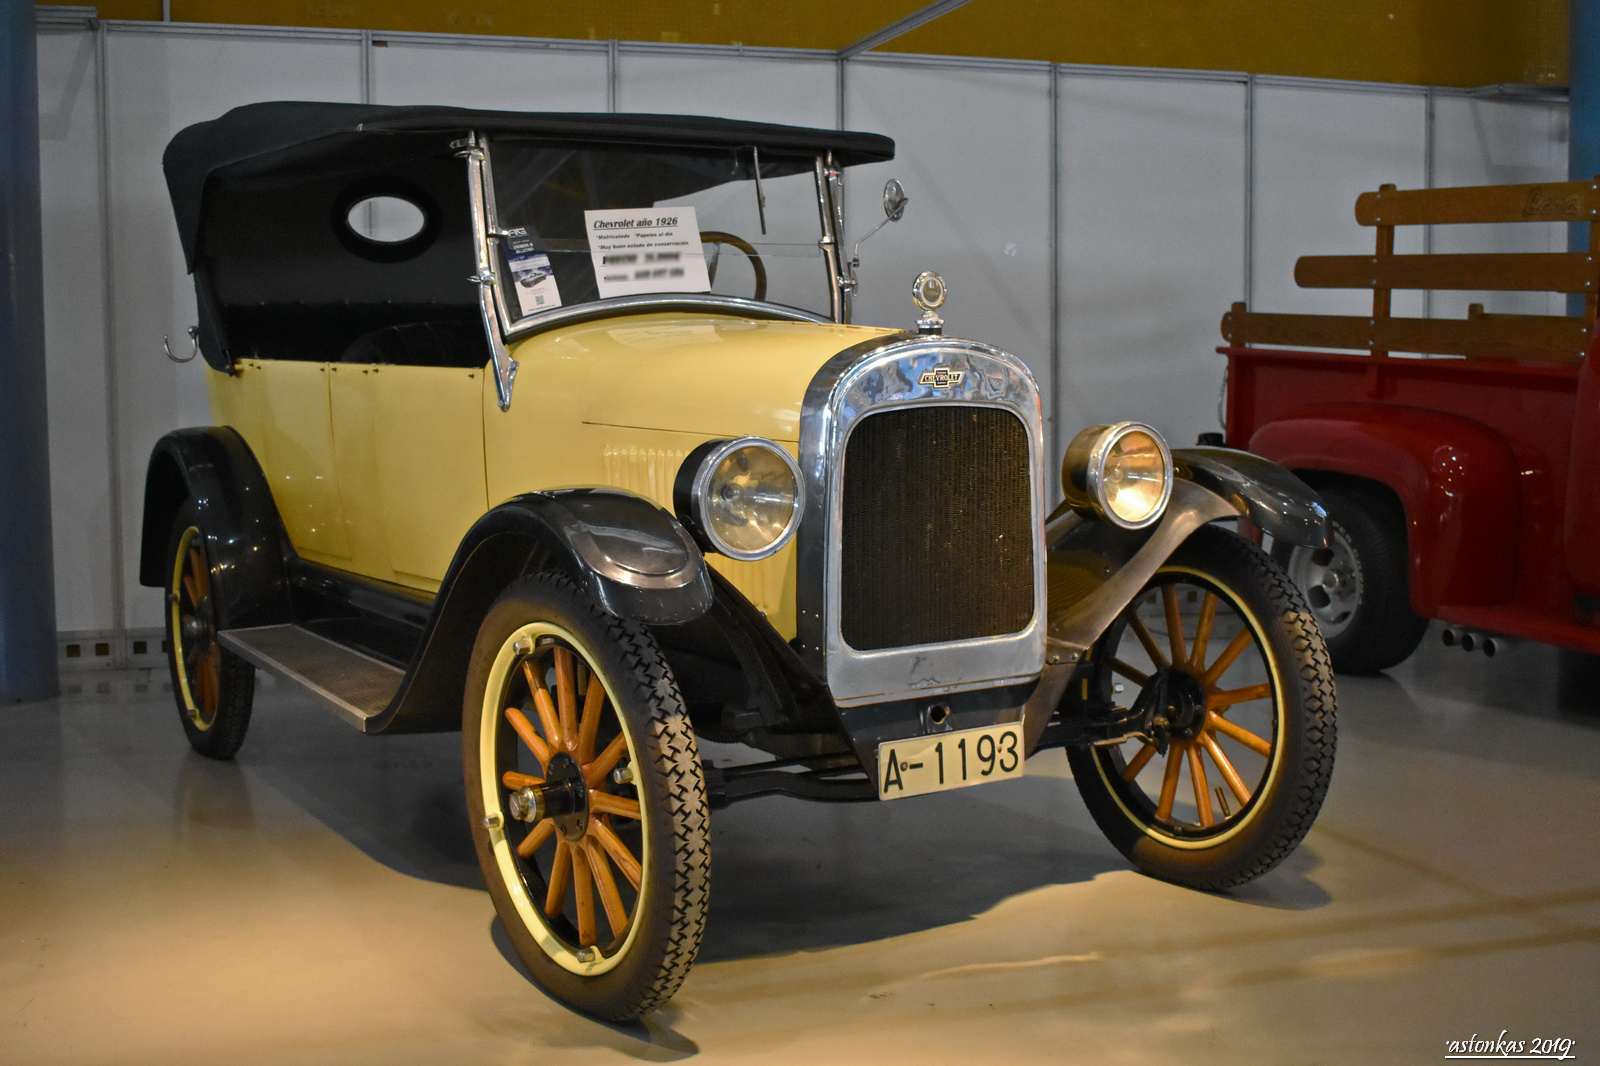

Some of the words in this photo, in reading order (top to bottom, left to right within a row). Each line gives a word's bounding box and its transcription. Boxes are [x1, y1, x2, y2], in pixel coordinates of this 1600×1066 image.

[593, 219, 634, 229] Chevrolet
[636, 218, 653, 227] año
[656, 217, 678, 226] 1926
[924, 373, 959, 382] CHEVROLET
[884, 731, 1019, 793] A-1193
